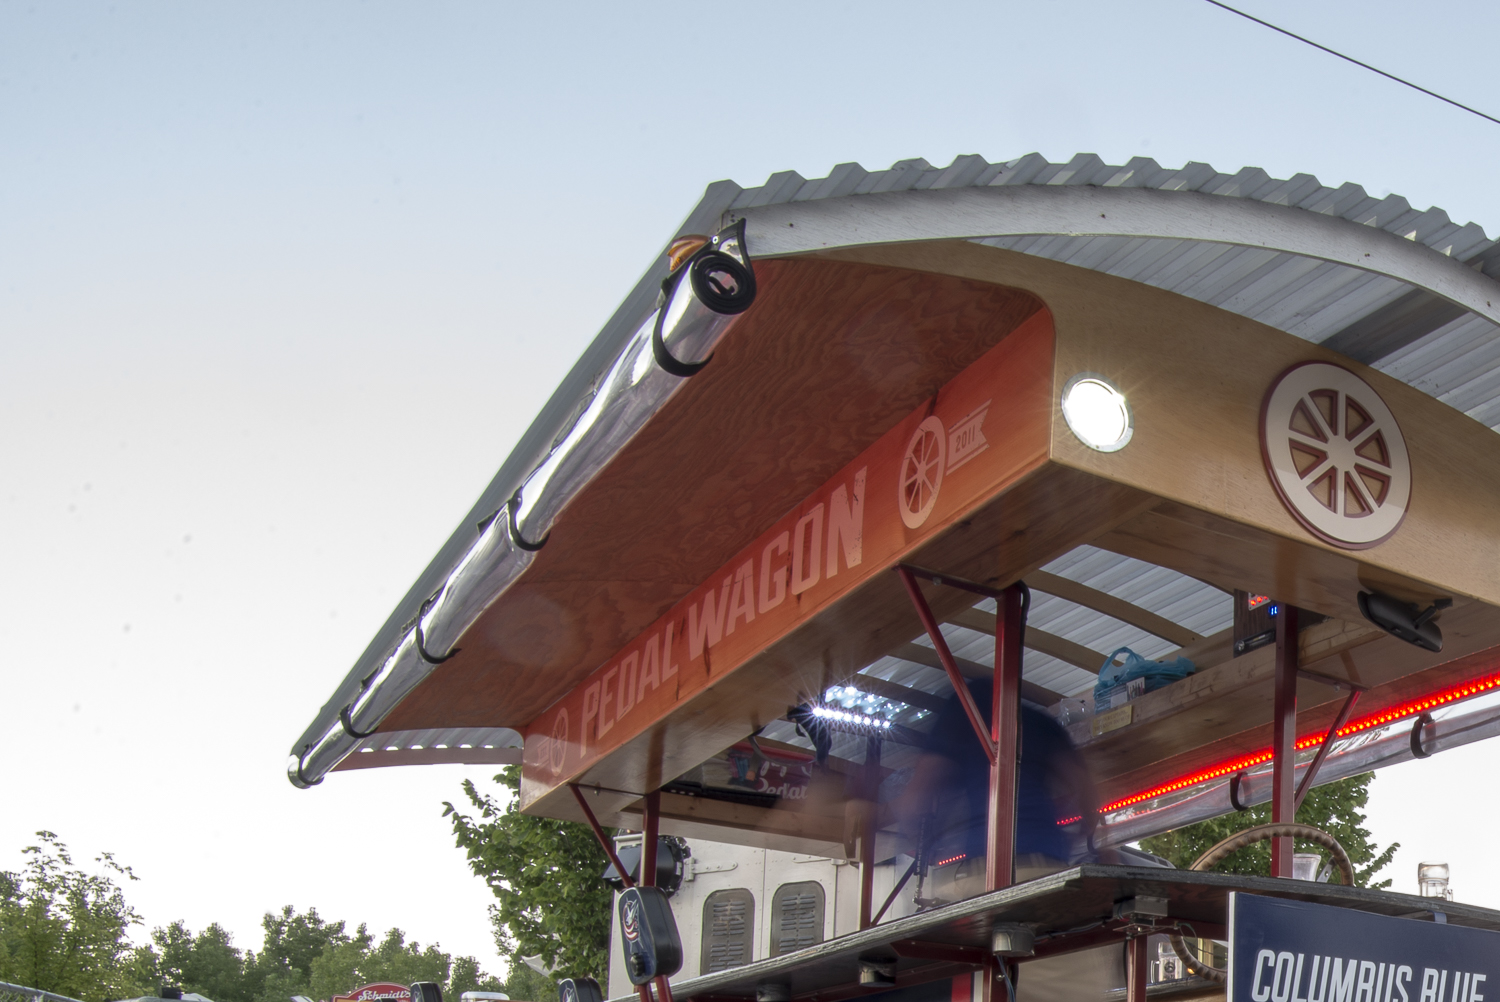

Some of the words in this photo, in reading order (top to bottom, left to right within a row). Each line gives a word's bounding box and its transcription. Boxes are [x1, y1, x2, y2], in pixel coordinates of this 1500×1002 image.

[955, 424, 976, 454] 2011
[580, 623, 681, 760] PEDAL
[687, 465, 868, 662] WAGON
